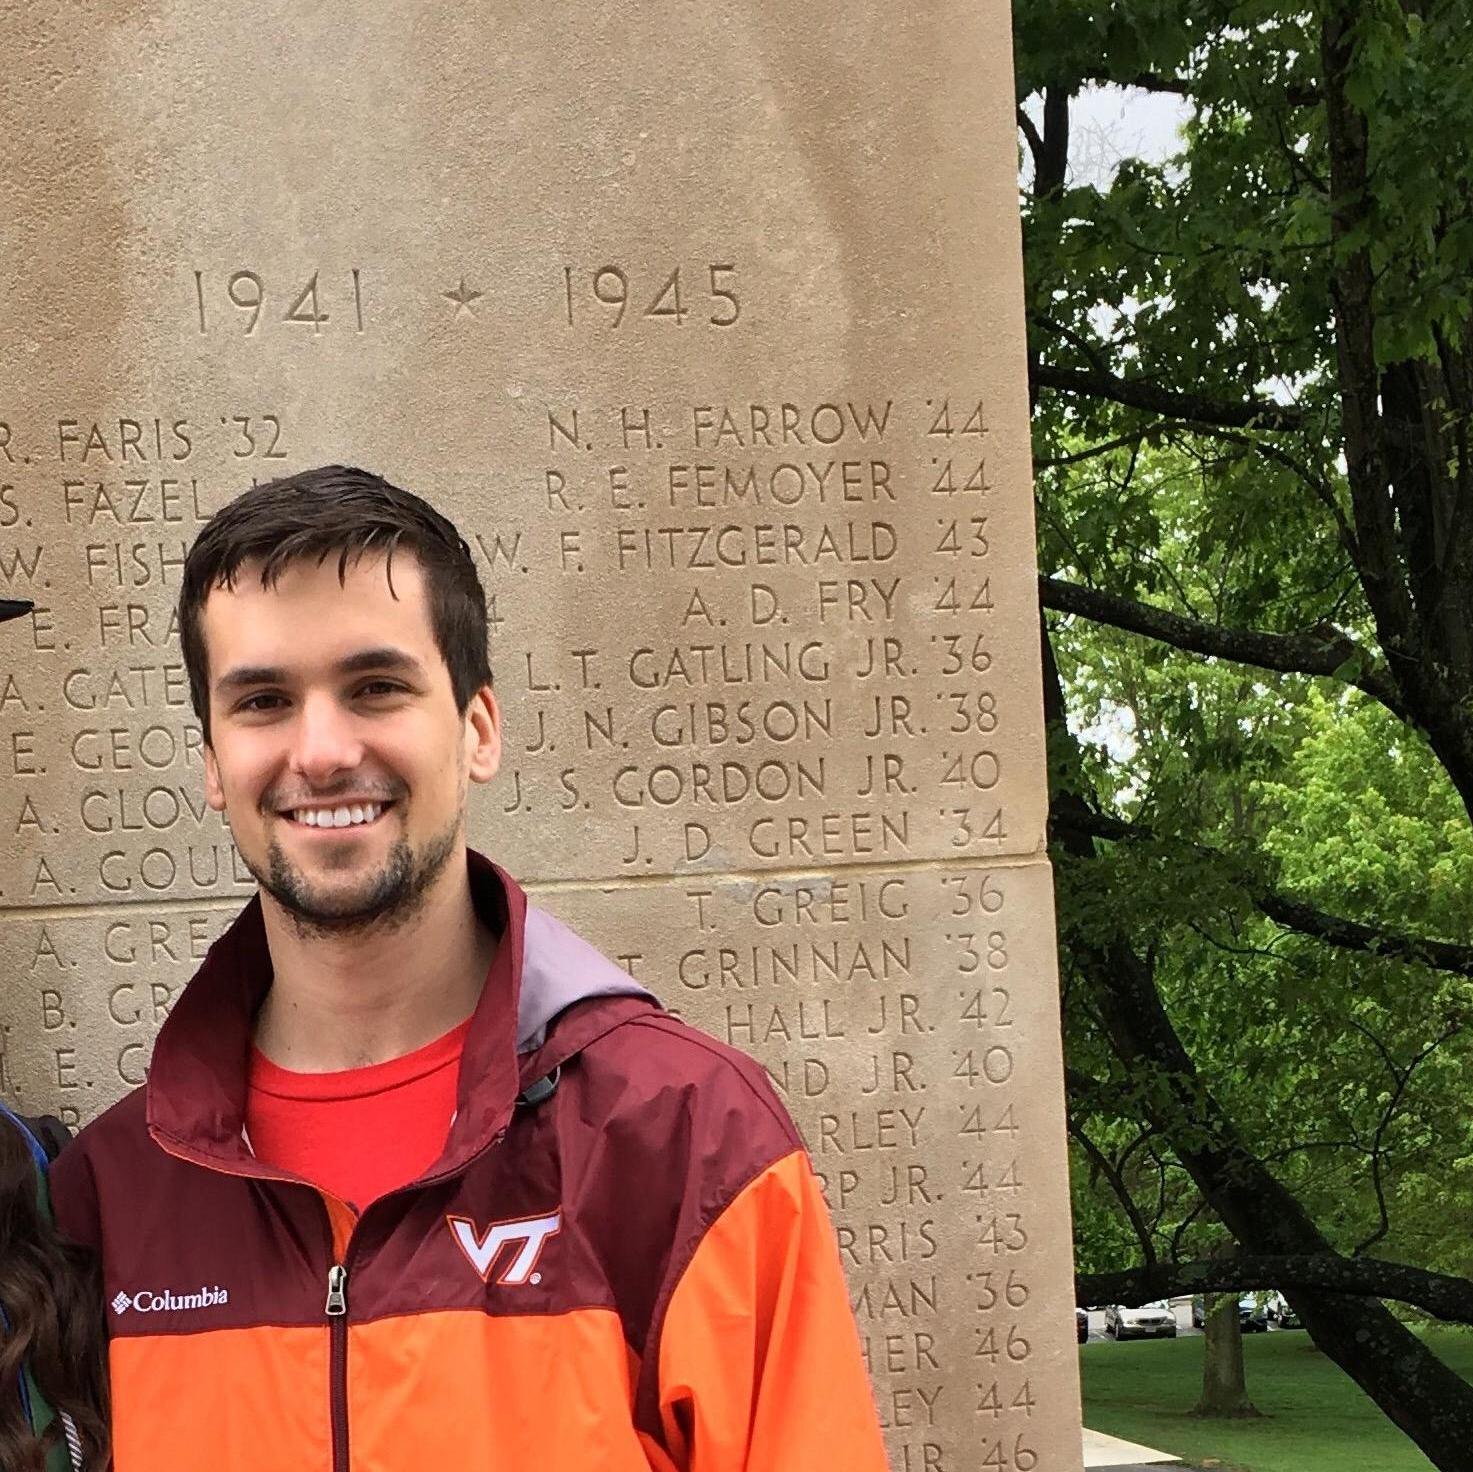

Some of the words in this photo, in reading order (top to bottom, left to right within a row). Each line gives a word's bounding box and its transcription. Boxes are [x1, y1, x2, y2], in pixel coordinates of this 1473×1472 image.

[194, 268, 366, 335] 1941
[564, 264, 741, 328] 1945
[58, 418, 192, 463] FARIS
[220, 414, 288, 459] '32
[548, 410, 593, 450] N.
[622, 409, 663, 449] H.
[695, 401, 893, 447] FARROW
[64, 478, 215, 524] FAZEL
[545, 470, 583, 511] R.
[610, 468, 645, 509] E.
[669, 460, 896, 508] FEMOYER
[476, 533, 528, 573] W.
[561, 531, 584, 573] F.
[618, 520, 898, 569] FITZGERALD
[682, 588, 726, 627] A.
[752, 584, 788, 625] D.
[819, 577, 902, 622] FRY
[31, 607, 71, 650] E.
[64, 663, 186, 711] GATE
[630, 639, 830, 691] GATLING
[857, 637, 917, 681] JR.
[526, 711, 555, 752] J.
[584, 707, 628, 751] N.
[651, 697, 832, 750] GIBSON
[865, 694, 927, 739] JR.
[13, 731, 47, 775] E.
[72, 725, 204, 771] GEOR
[504, 770, 533, 814] J.
[560, 768, 591, 811] S.
[613, 757, 826, 808] GORDON
[857, 754, 918, 797] JR.
[15, 796, 59, 834] A.
[81, 785, 230, 832] GLOV
[623, 825, 653, 866] J.
[749, 810, 909, 858] GREEN
[30, 857, 76, 896] A.
[686, 889, 717, 932] T.
[753, 878, 909, 927] GREIG
[30, 928, 77, 970] A.
[105, 918, 234, 964] GRE
[678, 936, 912, 991] GRINNAN
[42, 989, 76, 1029] B.
[109, 982, 189, 1026] GR
[727, 998, 845, 1046] HALL
[868, 993, 934, 1036] JR.
[56, 1049, 94, 1089] E.
[861, 1051, 926, 1094] JR.
[796, 1106, 926, 1153] RLEY
[881, 1164, 943, 1206] JR.
[446, 1205, 562, 1284] VT
[837, 1219, 937, 1265] RRIS
[133, 1286, 228, 1312] Columbia
[880, 1385, 944, 1428] EY
